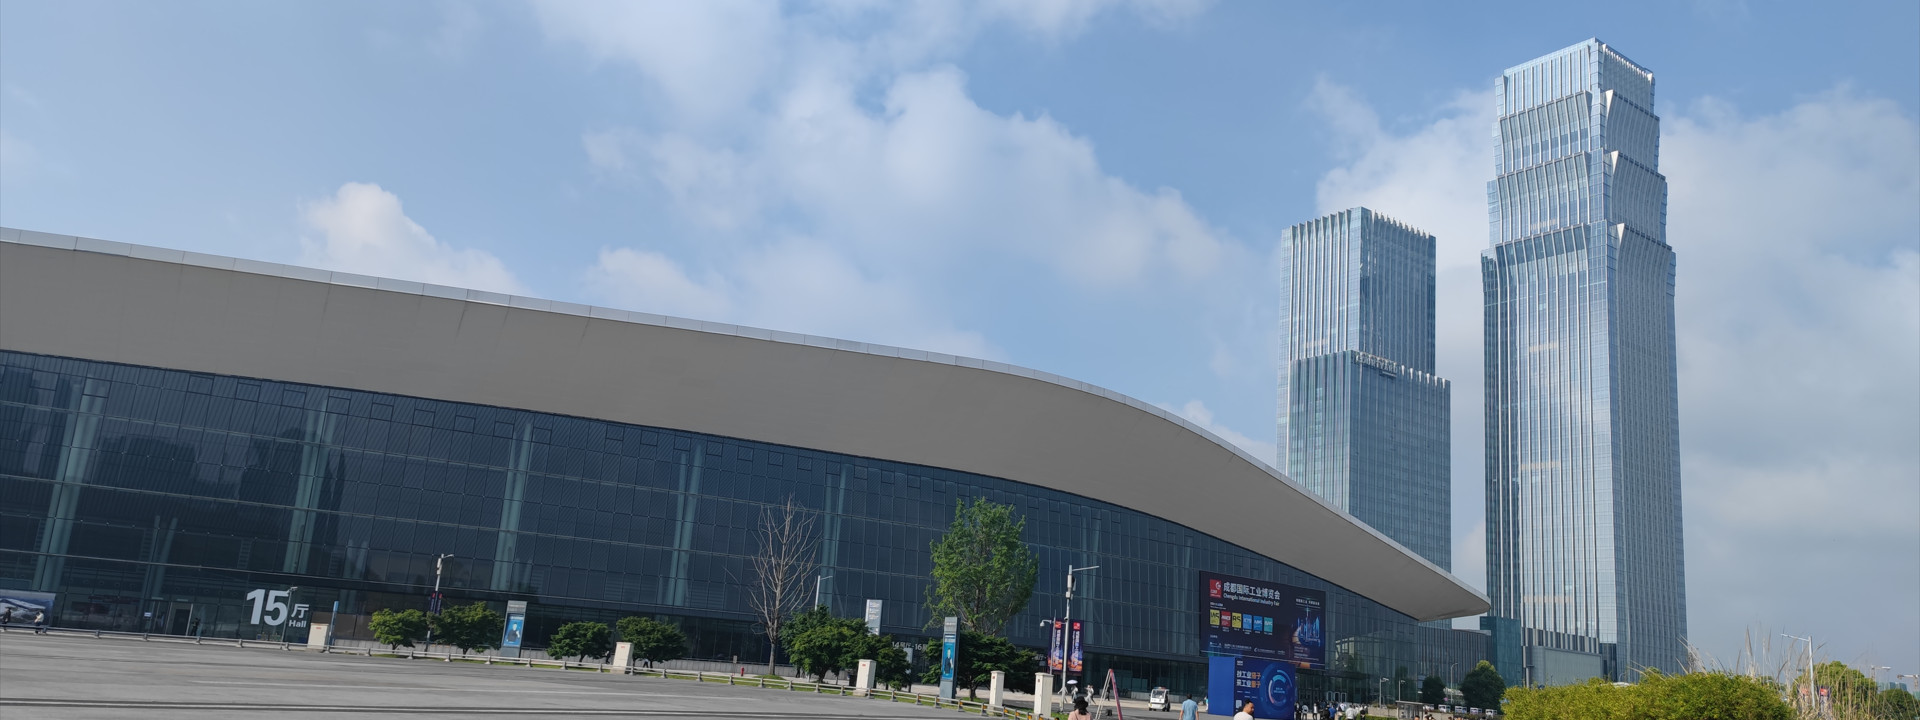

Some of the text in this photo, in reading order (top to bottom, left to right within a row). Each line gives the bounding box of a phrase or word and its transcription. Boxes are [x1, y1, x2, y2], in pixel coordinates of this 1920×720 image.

[1223, 592, 1239, 601] Chengdu
[1239, 595, 1260, 603] International
[1224, 582, 1280, 600] 成都国际工业博览会
[246, 588, 309, 626] 15 厅
[288, 620, 306, 628] Hall
